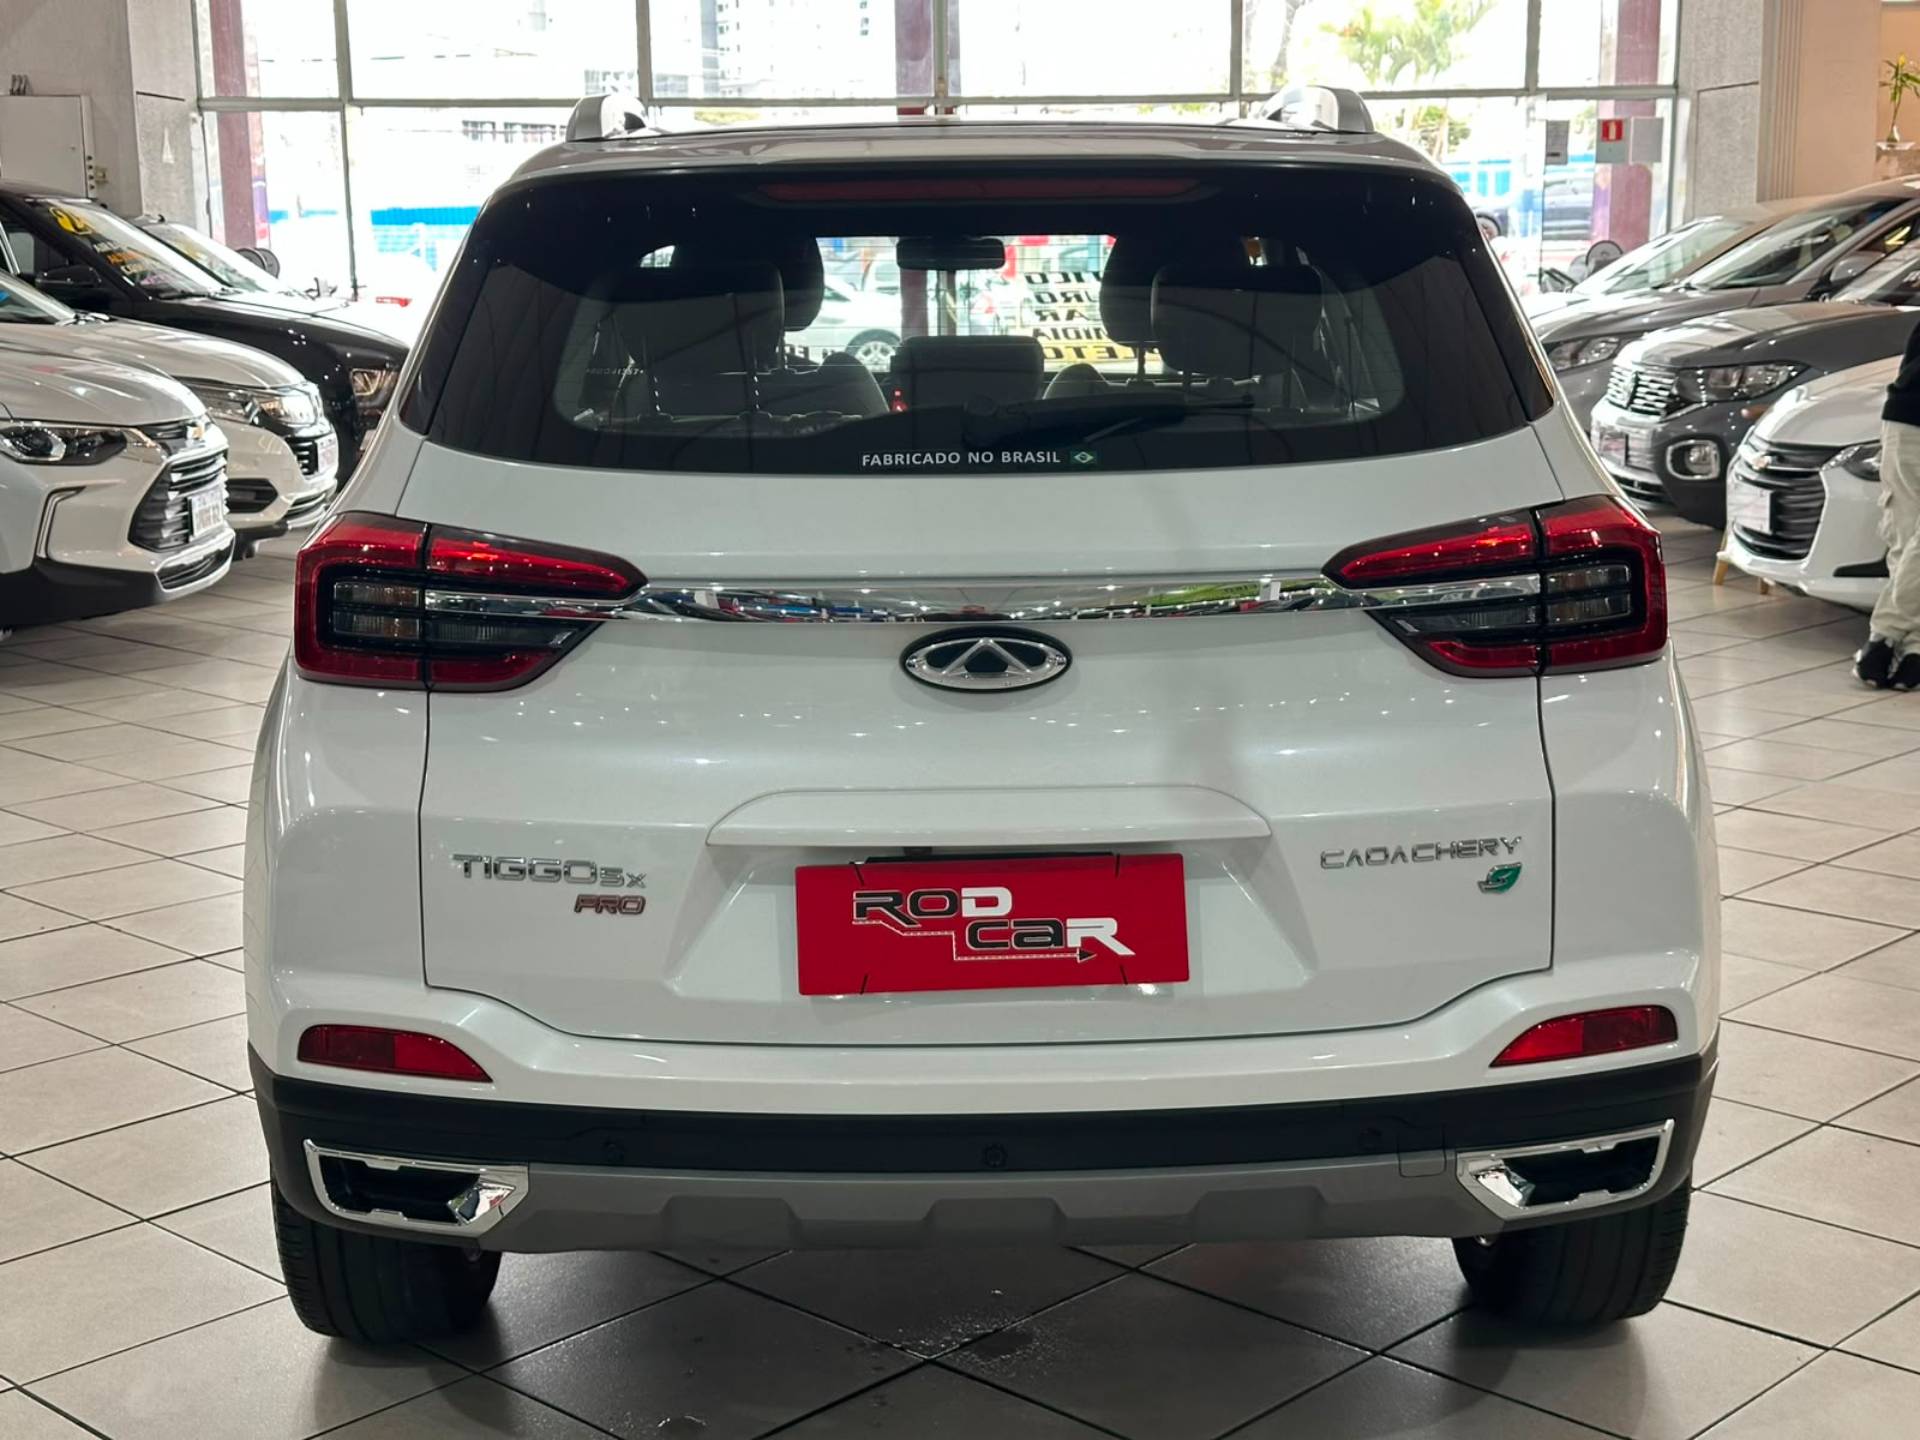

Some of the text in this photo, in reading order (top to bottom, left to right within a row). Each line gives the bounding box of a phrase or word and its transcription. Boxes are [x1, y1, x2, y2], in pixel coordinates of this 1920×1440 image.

[862, 451, 1061, 466] FABRICADO NO BRASIL
[573, 893, 647, 915] PRO
